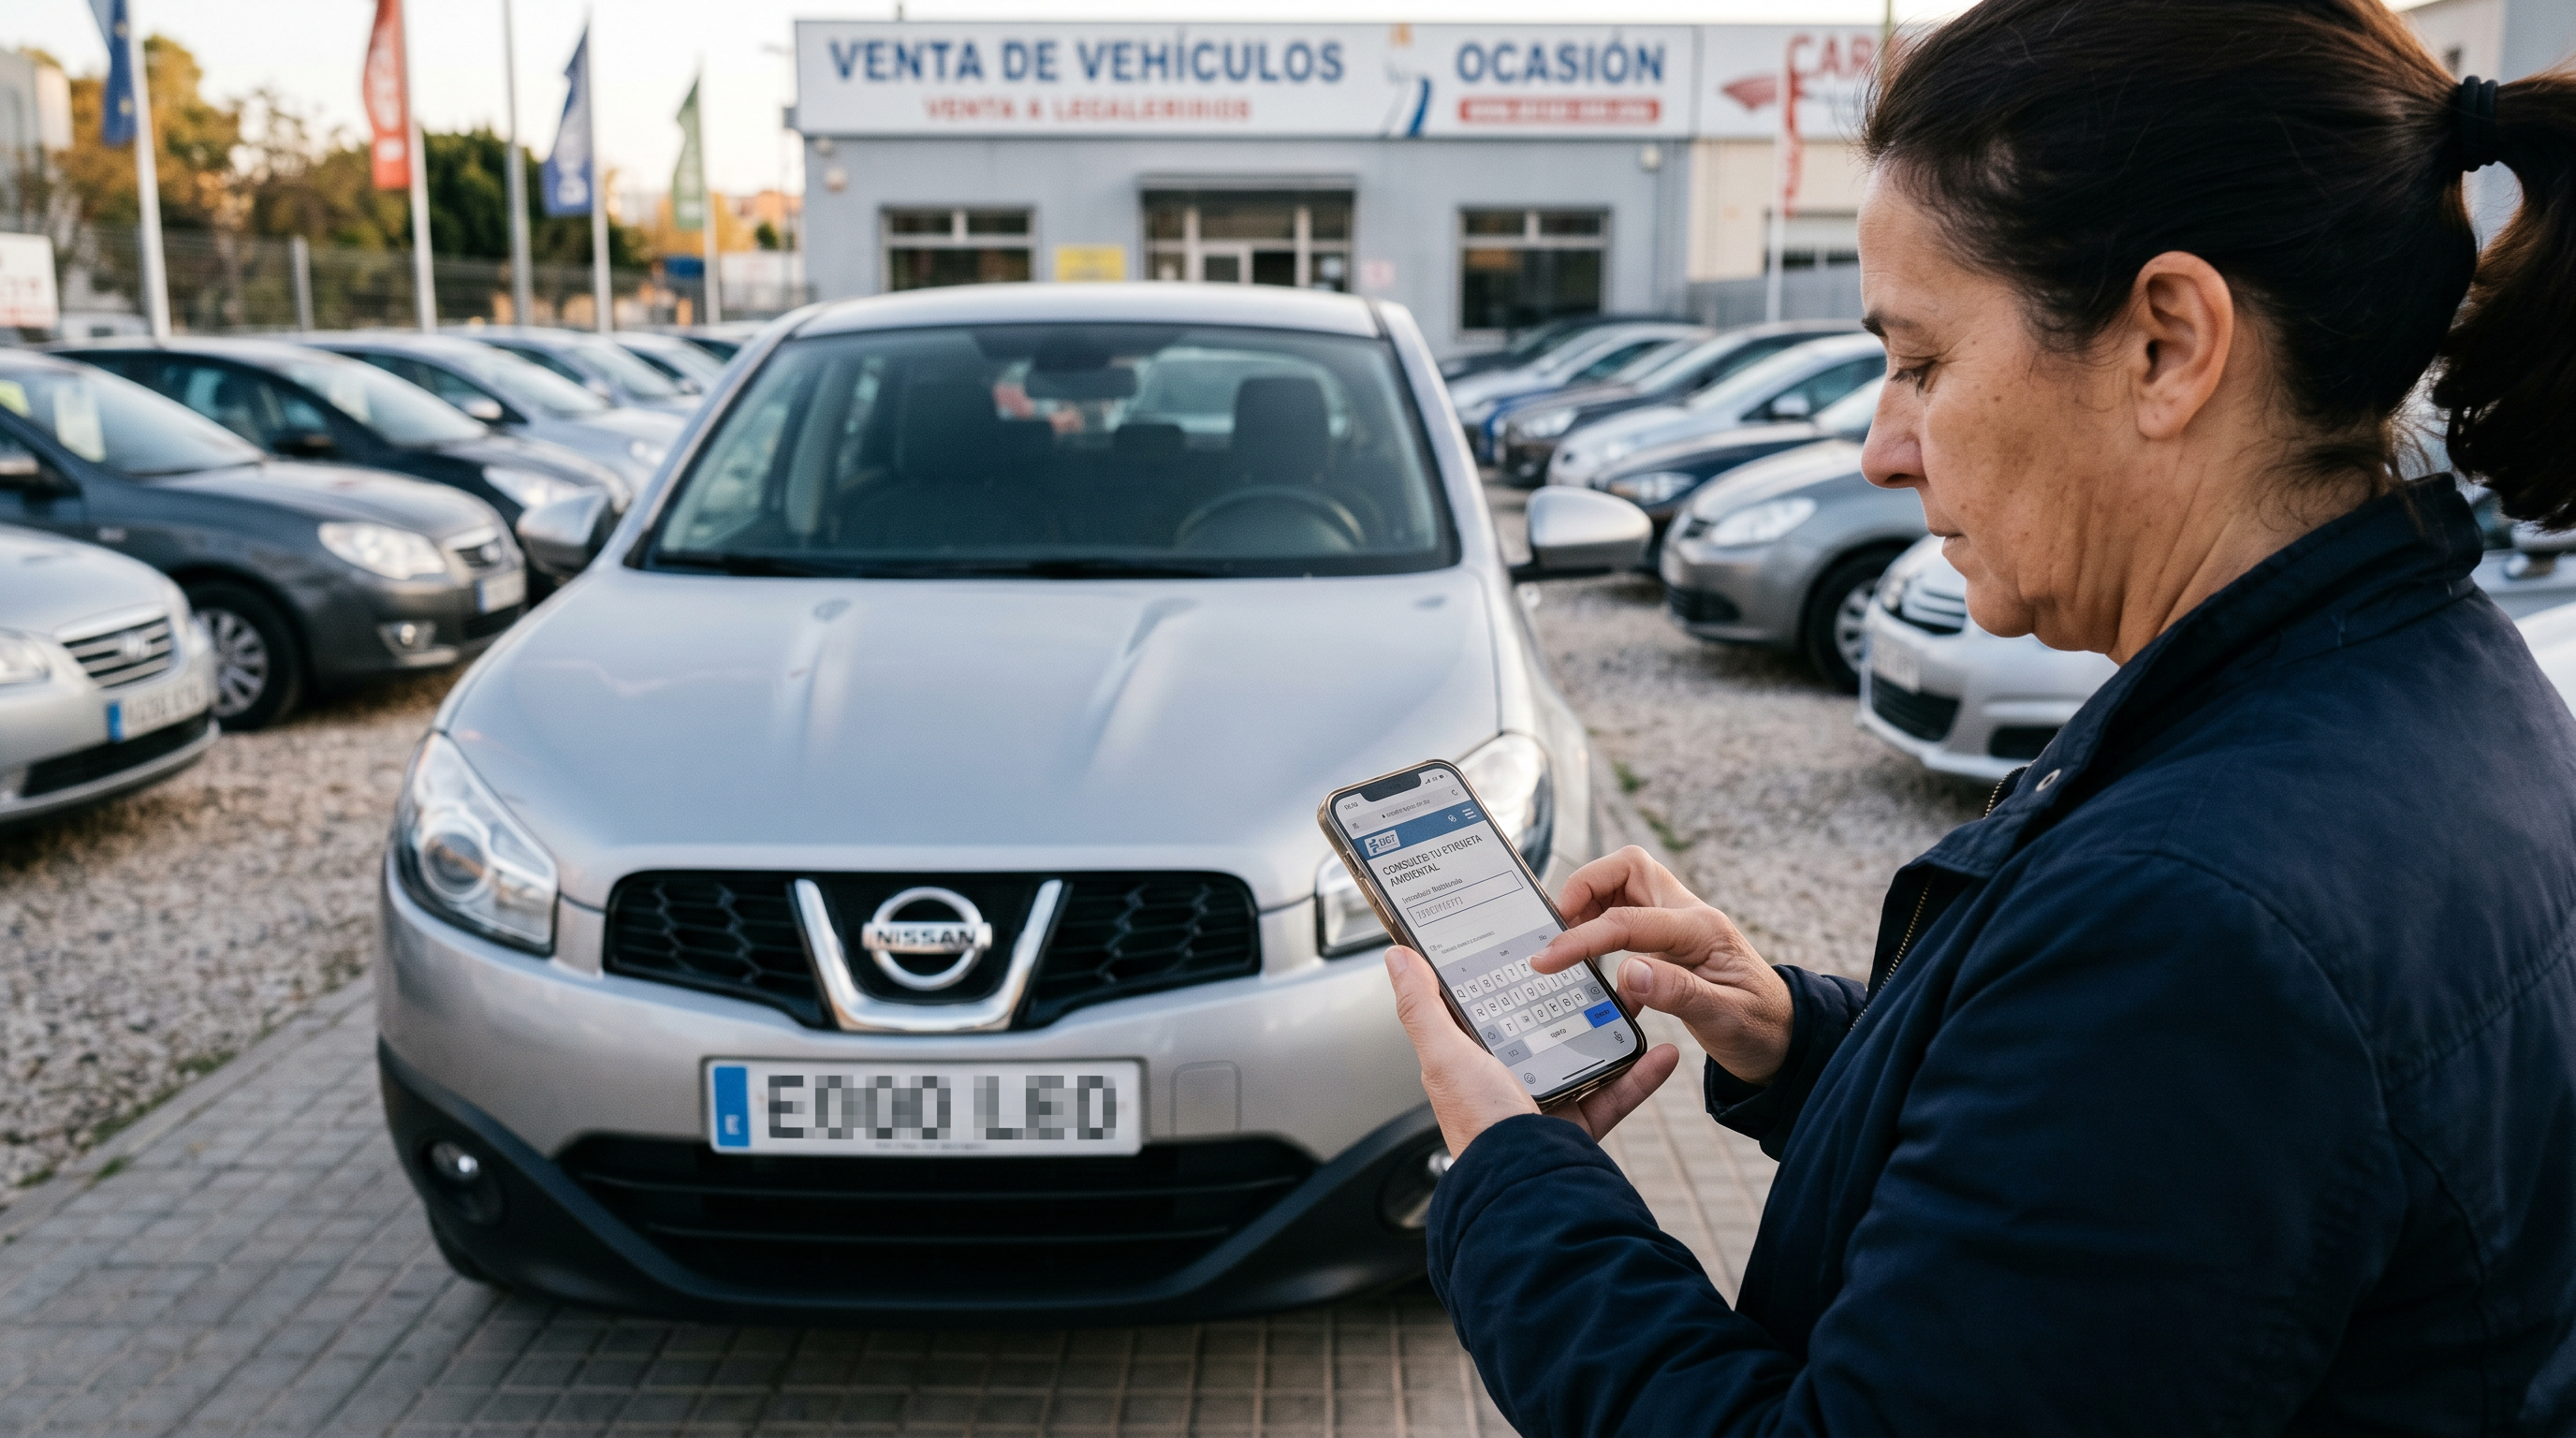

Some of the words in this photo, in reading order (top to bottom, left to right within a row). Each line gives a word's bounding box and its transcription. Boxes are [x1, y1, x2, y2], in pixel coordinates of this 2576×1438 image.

[827, 39, 985, 82] VENTA
[1002, 39, 1059, 82] DE
[1076, 26, 1346, 83] VEHÍCULOS
[1456, 27, 1665, 83] OCASIÓN
[1428, 849, 1442, 858] TU
[877, 929, 975, 946] NISSAN
